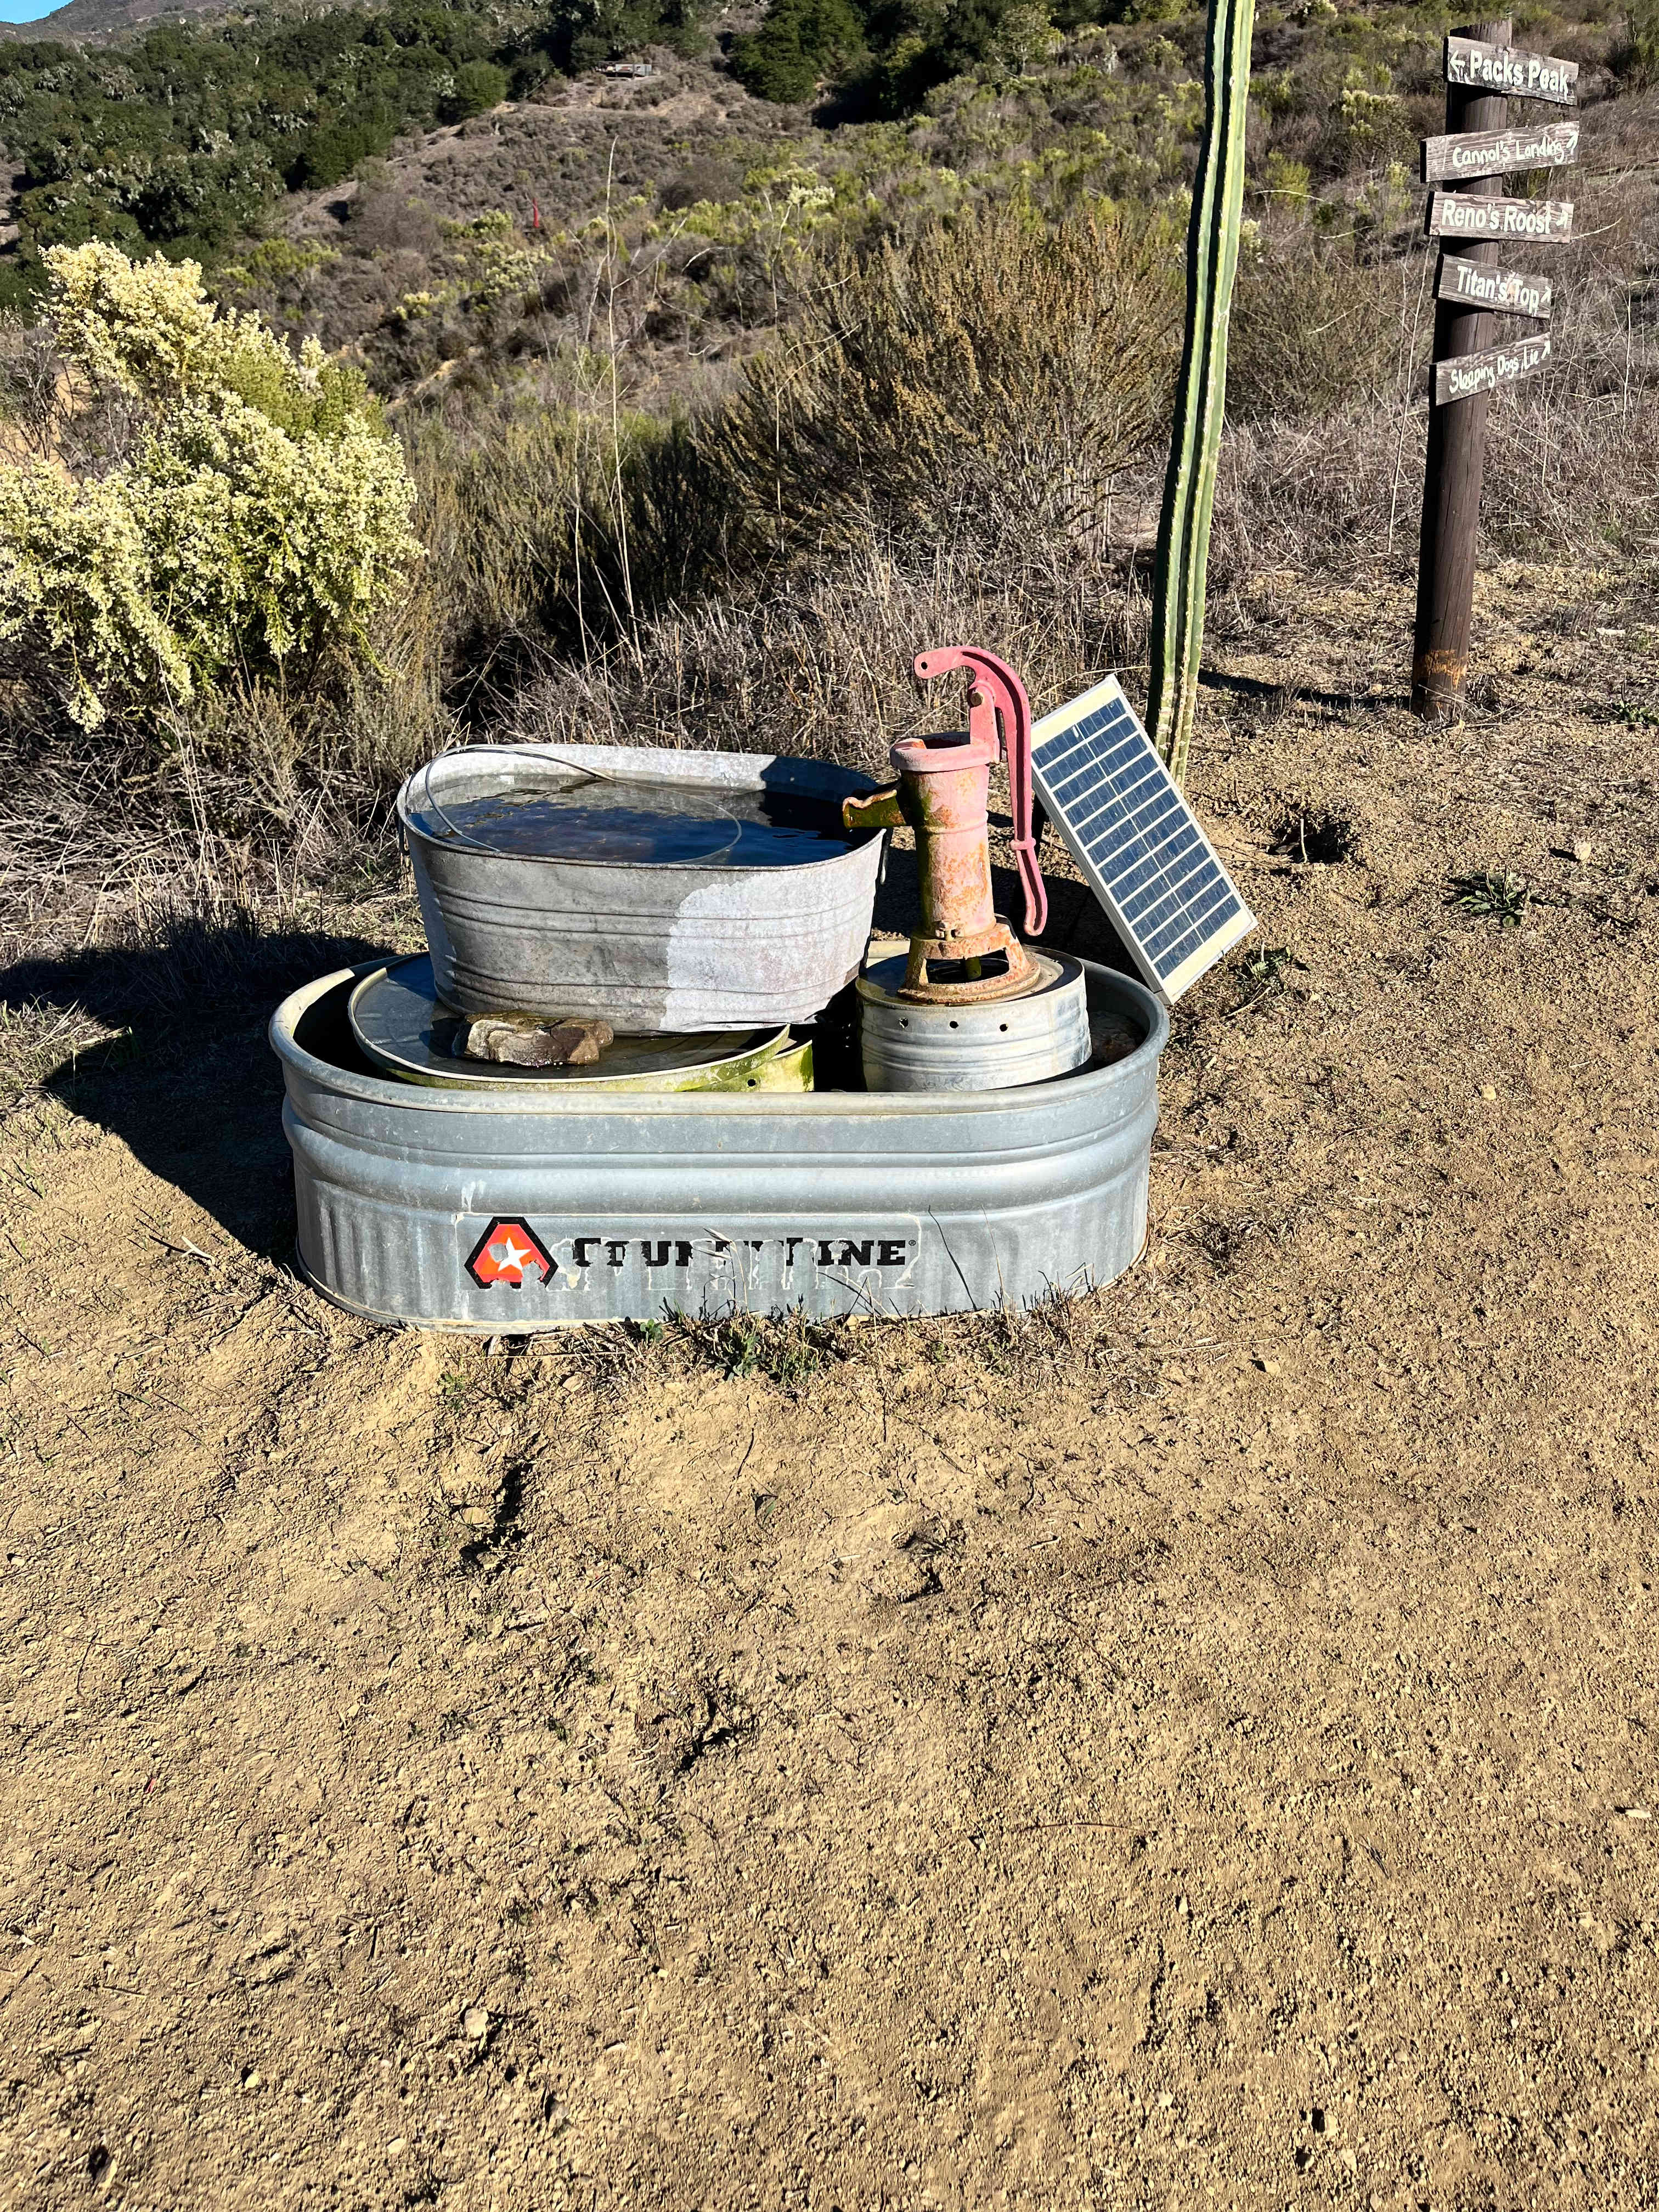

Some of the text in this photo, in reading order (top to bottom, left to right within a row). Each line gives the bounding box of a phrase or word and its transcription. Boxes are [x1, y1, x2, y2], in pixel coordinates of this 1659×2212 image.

[1470, 49, 1569, 97] Packs Peak
[1442, 199, 1551, 234] Reno's Roost
[1458, 266, 1539, 314] Titan's Top
[1448, 346, 1539, 394] Sleeping Dogs Lie
